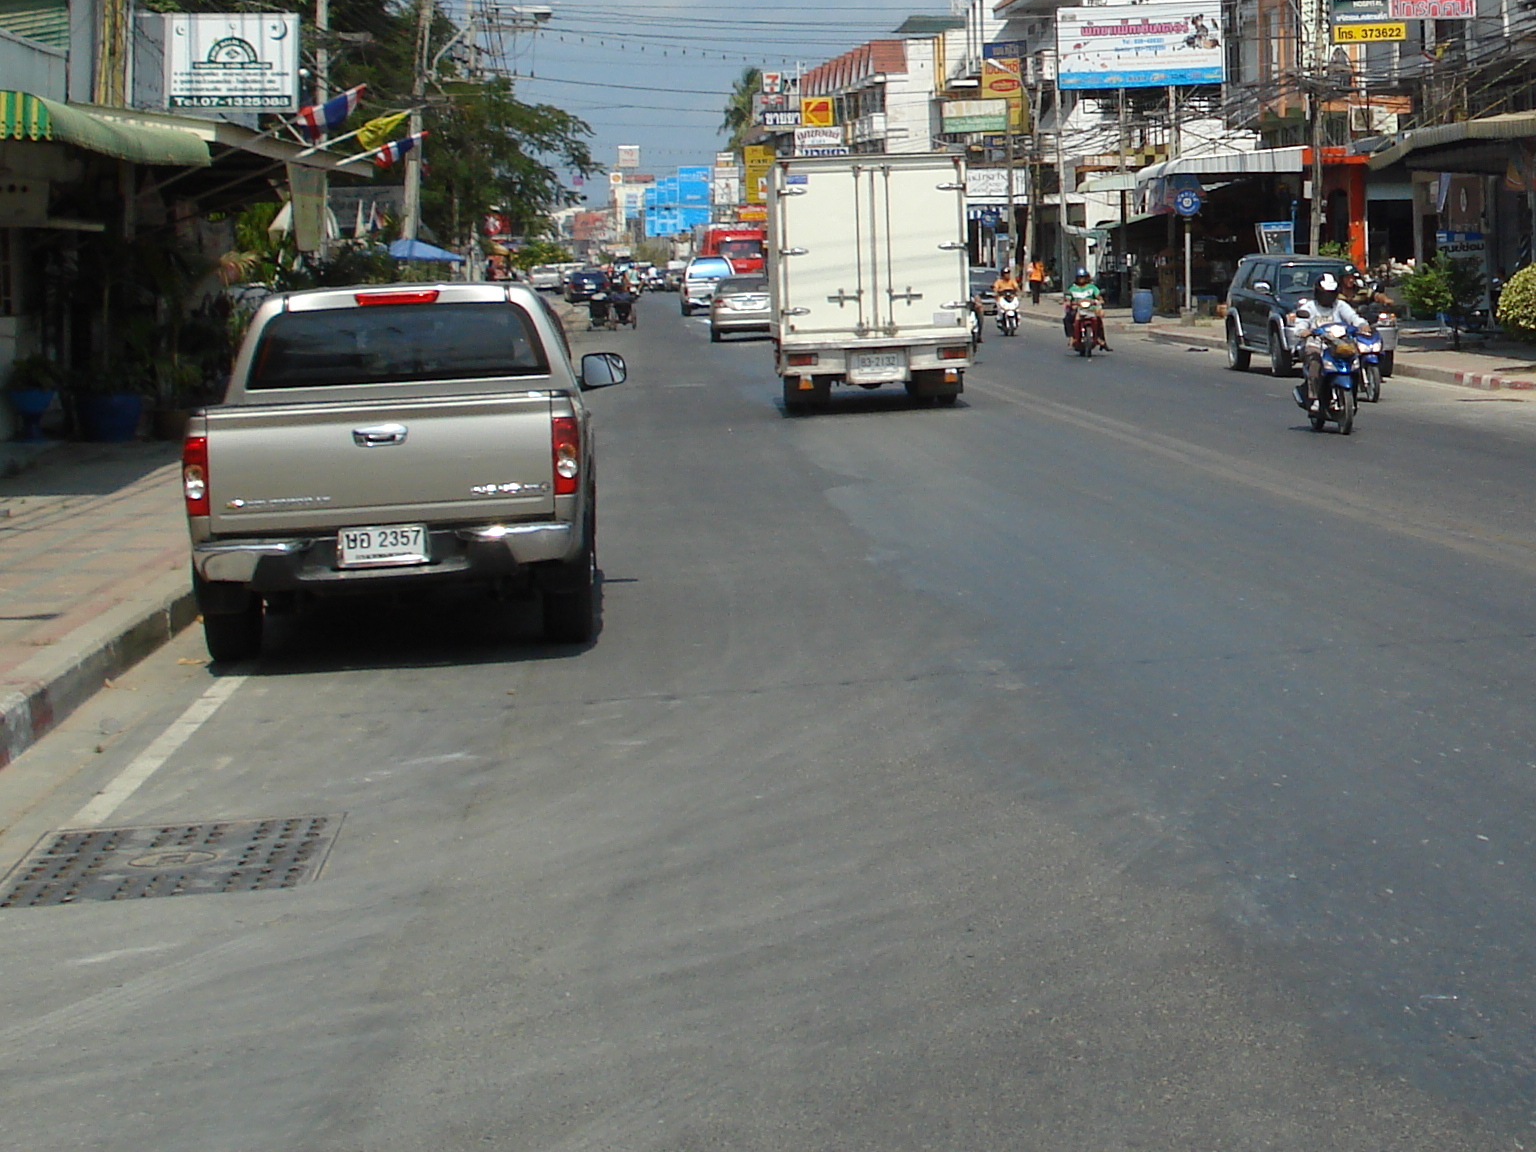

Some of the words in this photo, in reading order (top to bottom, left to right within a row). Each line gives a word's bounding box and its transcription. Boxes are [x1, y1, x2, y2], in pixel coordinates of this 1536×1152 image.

[1353, 0, 1383, 8] HOSPITAL
[1338, 27, 1357, 40] โทร.
[1361, 27, 1402, 39] 373622
[378, 529, 421, 548] 2357
